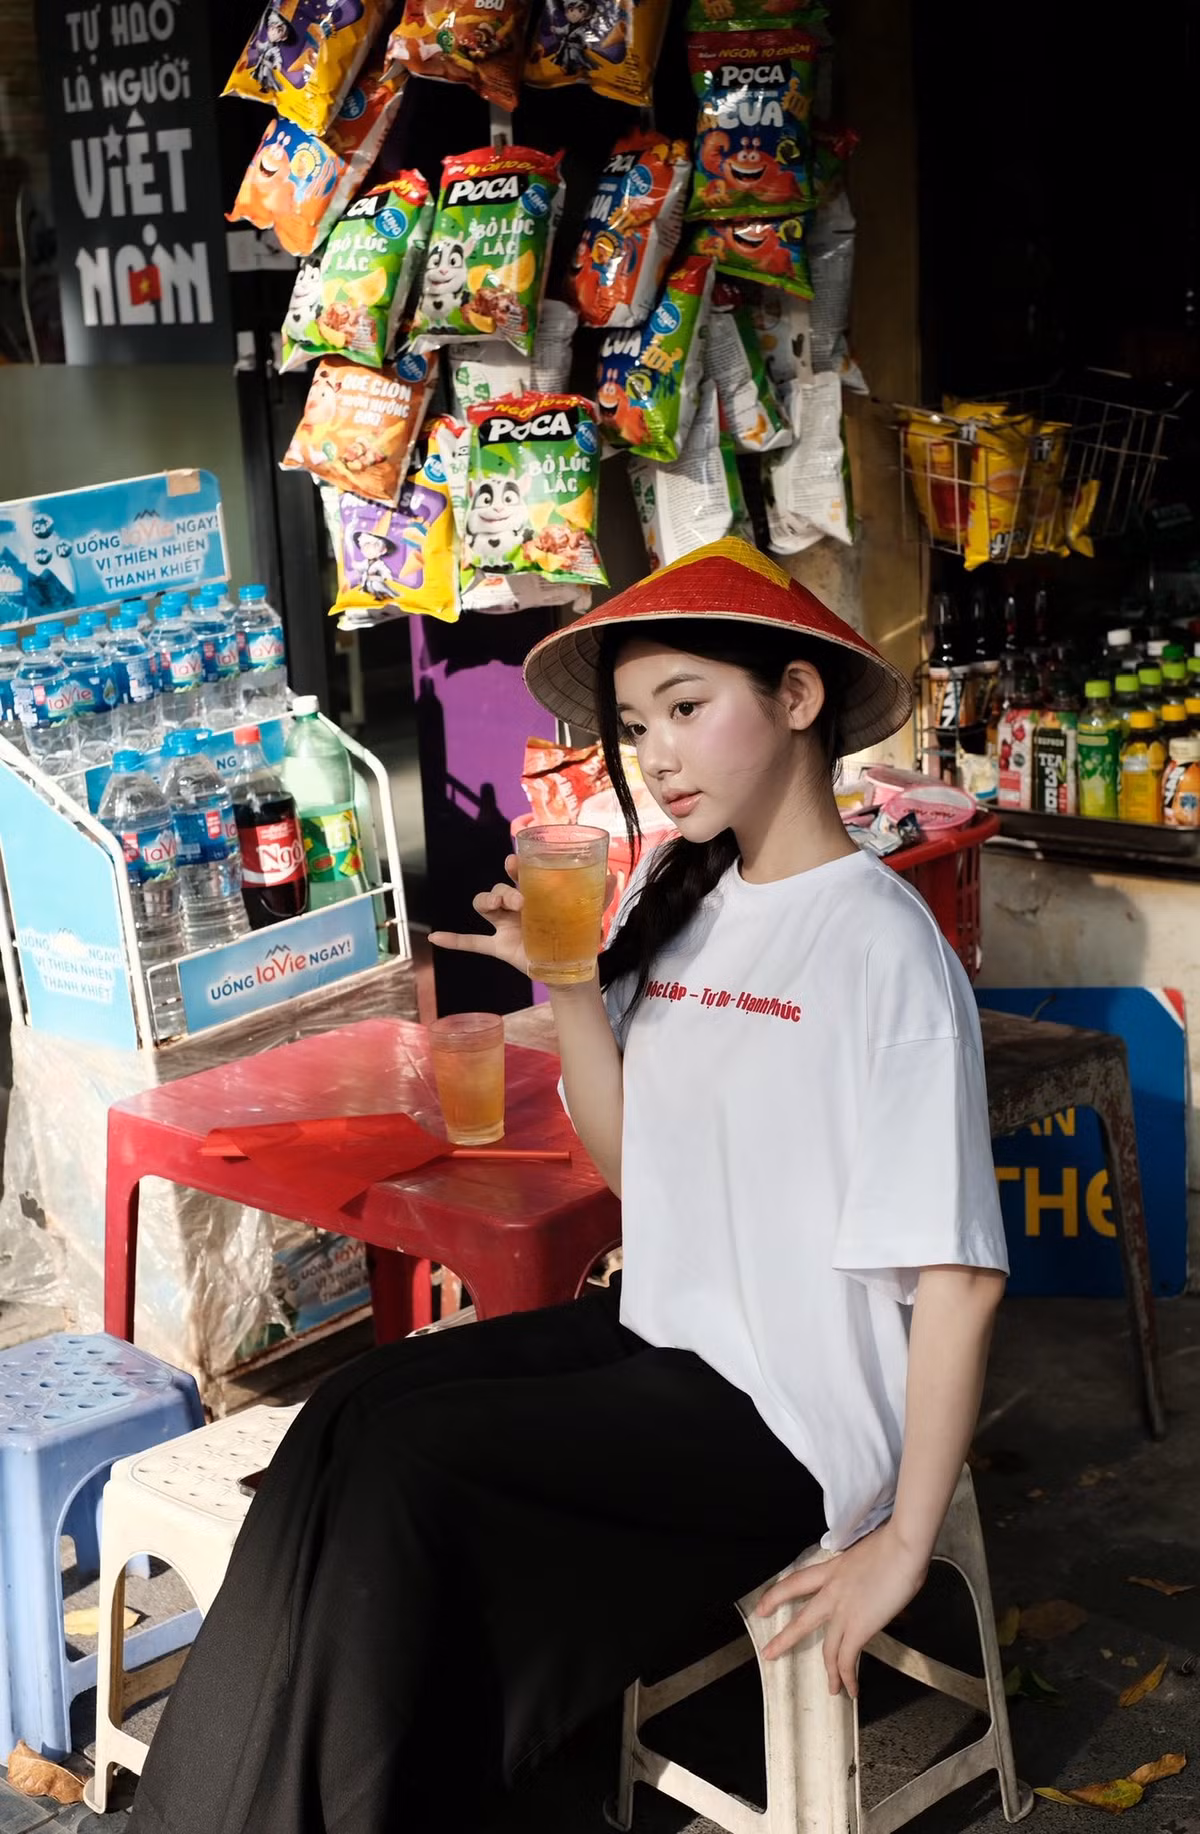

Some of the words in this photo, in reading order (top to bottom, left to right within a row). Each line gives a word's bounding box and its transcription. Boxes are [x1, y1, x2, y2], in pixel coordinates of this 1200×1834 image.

[721, 65, 785, 87] POCA
[718, 100, 784, 129] CUA
[448, 175, 519, 205] POCA
[590, 195, 613, 222] UA
[501, 212, 535, 235] LÚC
[355, 231, 389, 253] LÚC
[487, 411, 573, 442] POCA
[559, 451, 591, 472] LÚC
[76, 532, 121, 555] UỐNG
[175, 514, 219, 535] NGAY!
[95, 557, 112, 574] VỊ
[115, 545, 159, 568] THIÊN
[105, 567, 157, 590] THANH
[160, 554, 201, 578] KHIẾT
[48, 686, 92, 711] laVie
[211, 975, 255, 1001] UỐNG
[255, 952, 307, 985] laVie
[309, 940, 352, 966] NGAY!
